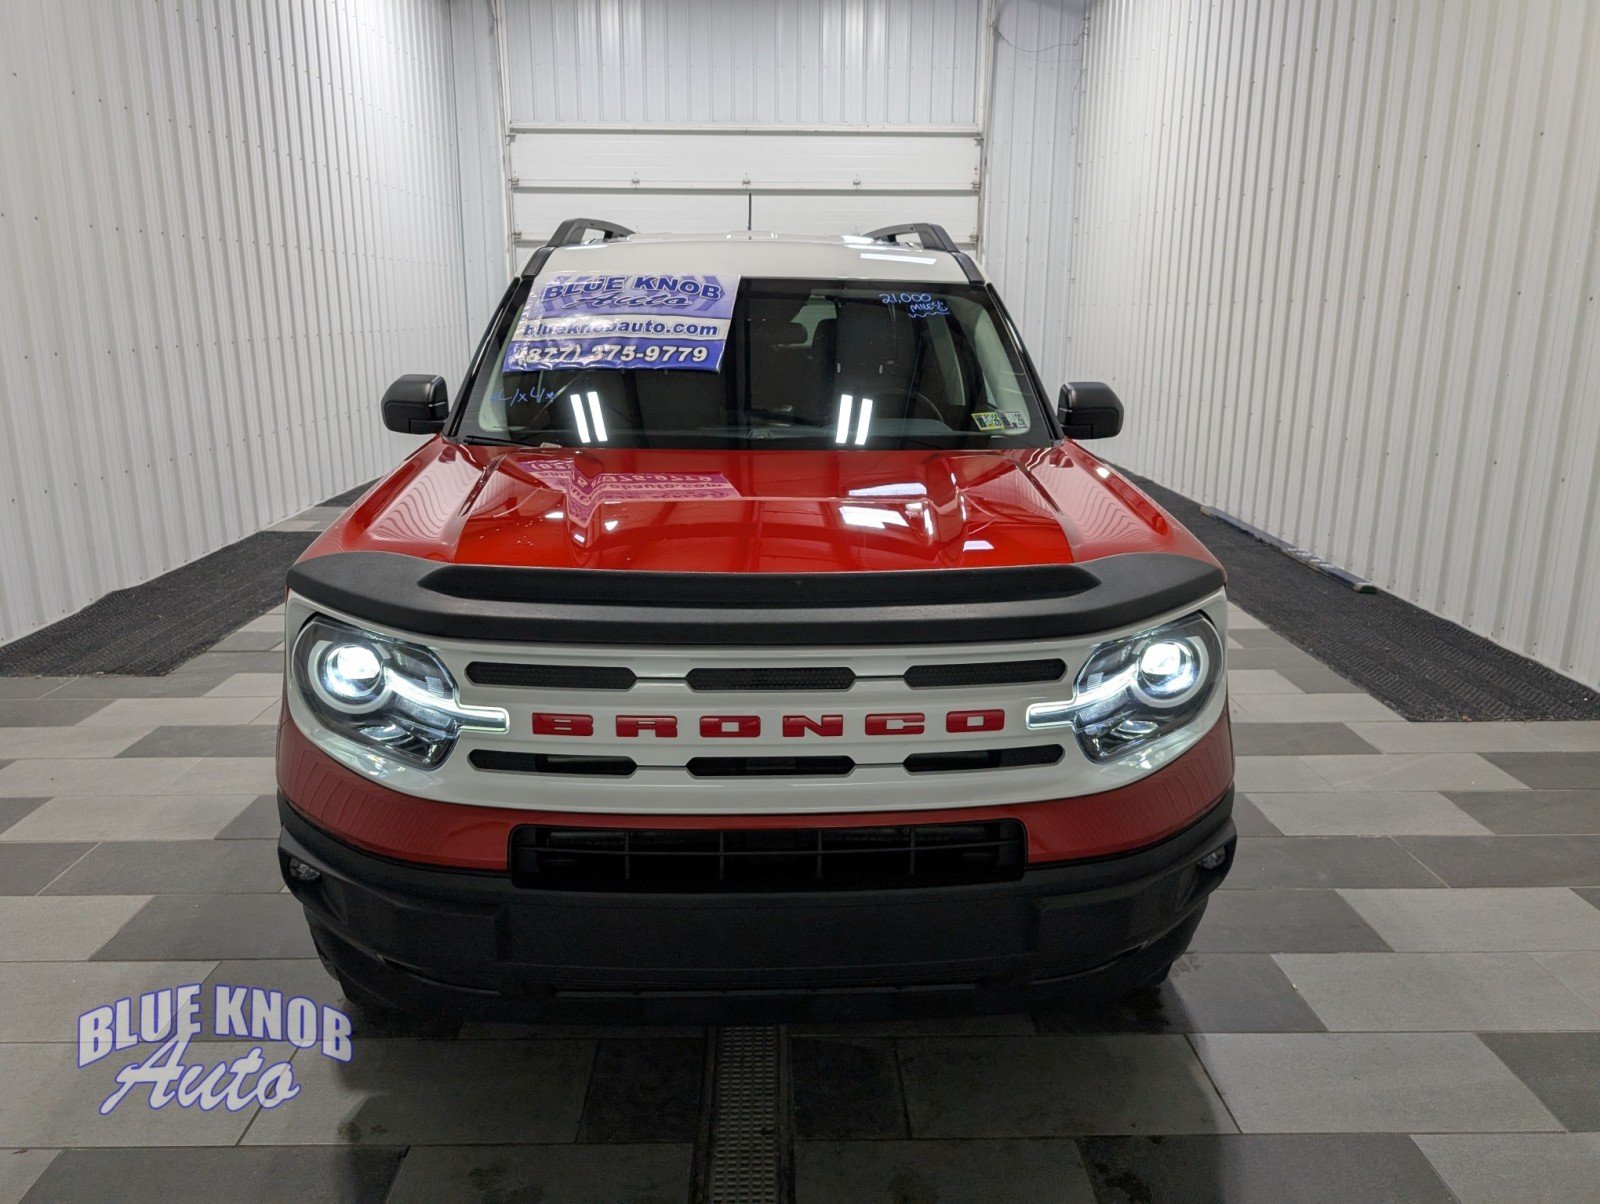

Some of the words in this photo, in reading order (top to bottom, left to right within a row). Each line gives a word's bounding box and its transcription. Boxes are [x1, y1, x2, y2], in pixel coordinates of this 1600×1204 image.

[543, 276, 626, 300] BLUE
[633, 276, 723, 299] KNOB
[563, 291, 692, 309] Auto
[878, 293, 931, 304] 21,000
[523, 320, 718, 336] blueknobauto.com
[515, 343, 582, 366] (877)
[591, 345, 708, 363] 375-9779
[532, 708, 1005, 738] BRONCO
